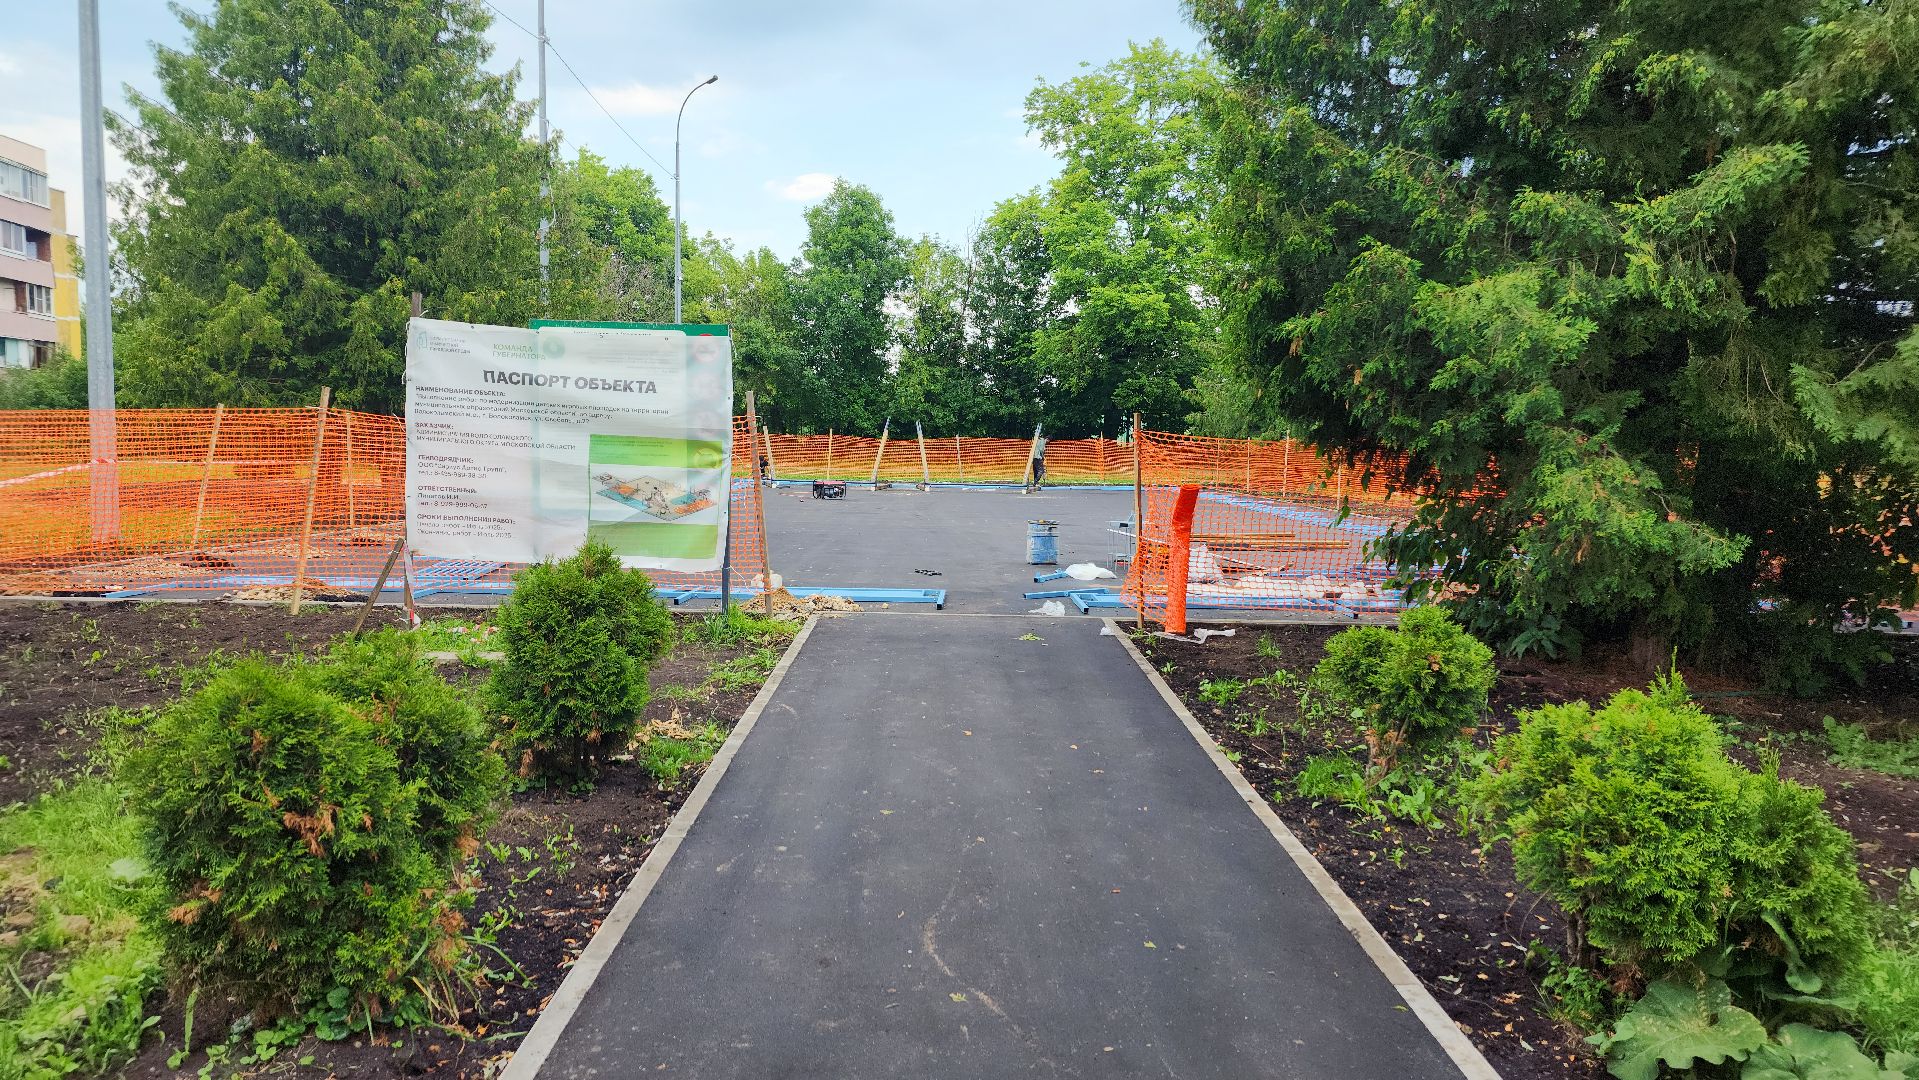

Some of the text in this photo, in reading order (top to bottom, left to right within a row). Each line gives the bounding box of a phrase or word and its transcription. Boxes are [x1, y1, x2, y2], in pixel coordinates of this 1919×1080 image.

[493, 344, 533, 352] КОМАНДА
[492, 351, 546, 360] ГУБЕРНАТОРА
[483, 369, 657, 394] ПАСПОРТ ОБЪЕКТА
[415, 386, 472, 395] НАИМЕНОВАНИЕ
